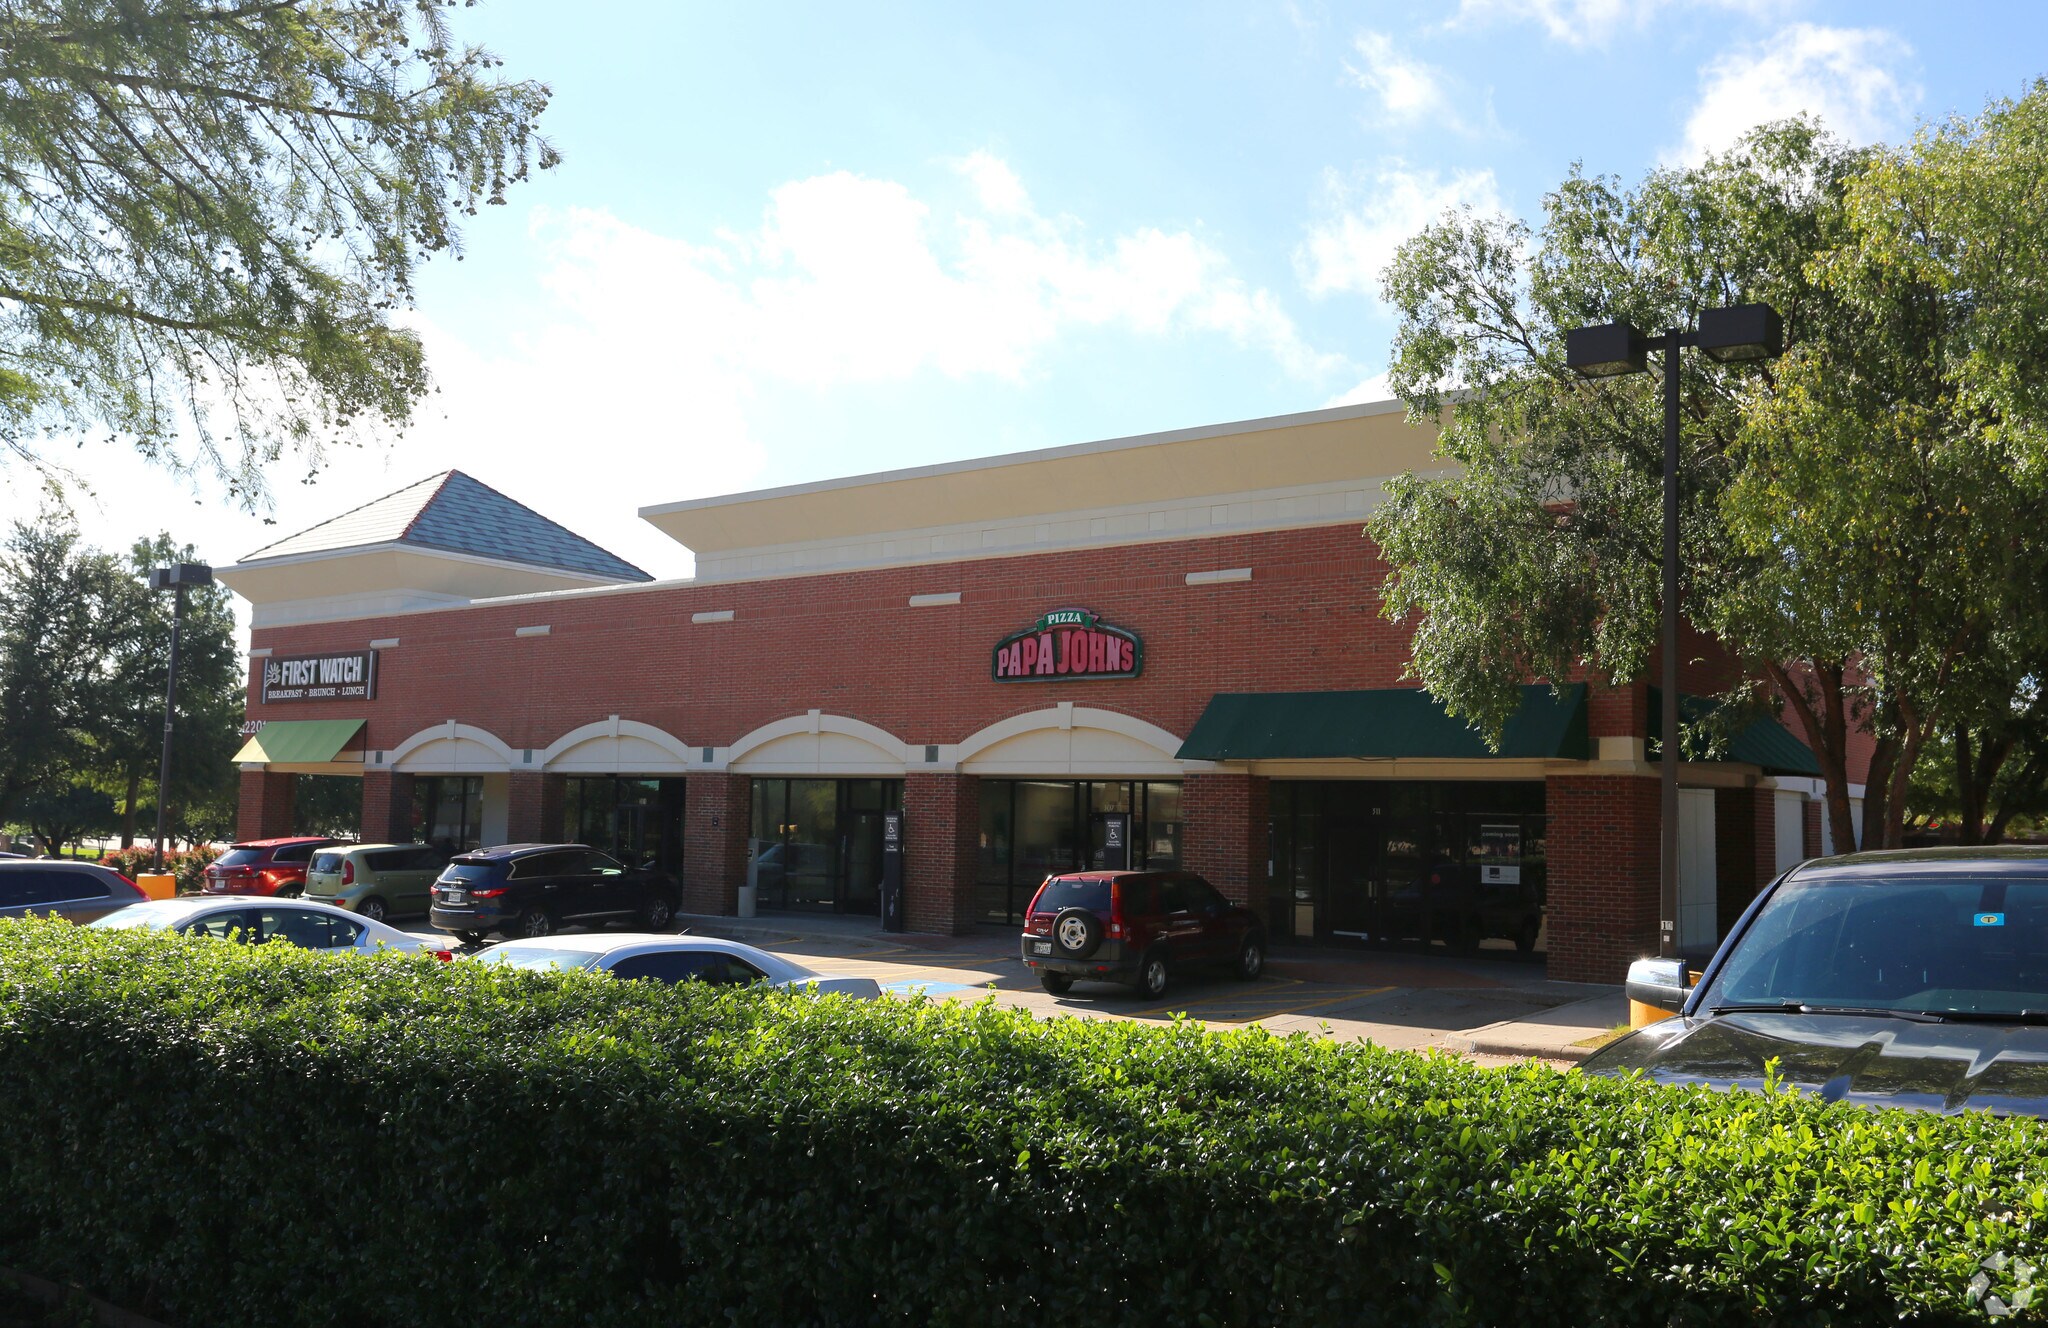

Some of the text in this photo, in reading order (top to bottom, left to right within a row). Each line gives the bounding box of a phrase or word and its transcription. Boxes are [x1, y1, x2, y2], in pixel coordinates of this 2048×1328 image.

[1047, 612, 1082, 625] PIZZA
[997, 633, 1055, 677] PAPA
[281, 656, 363, 687] FIRST WATCH
[268, 686, 365, 699] BREAKFAST BRUNCH LUNCH
